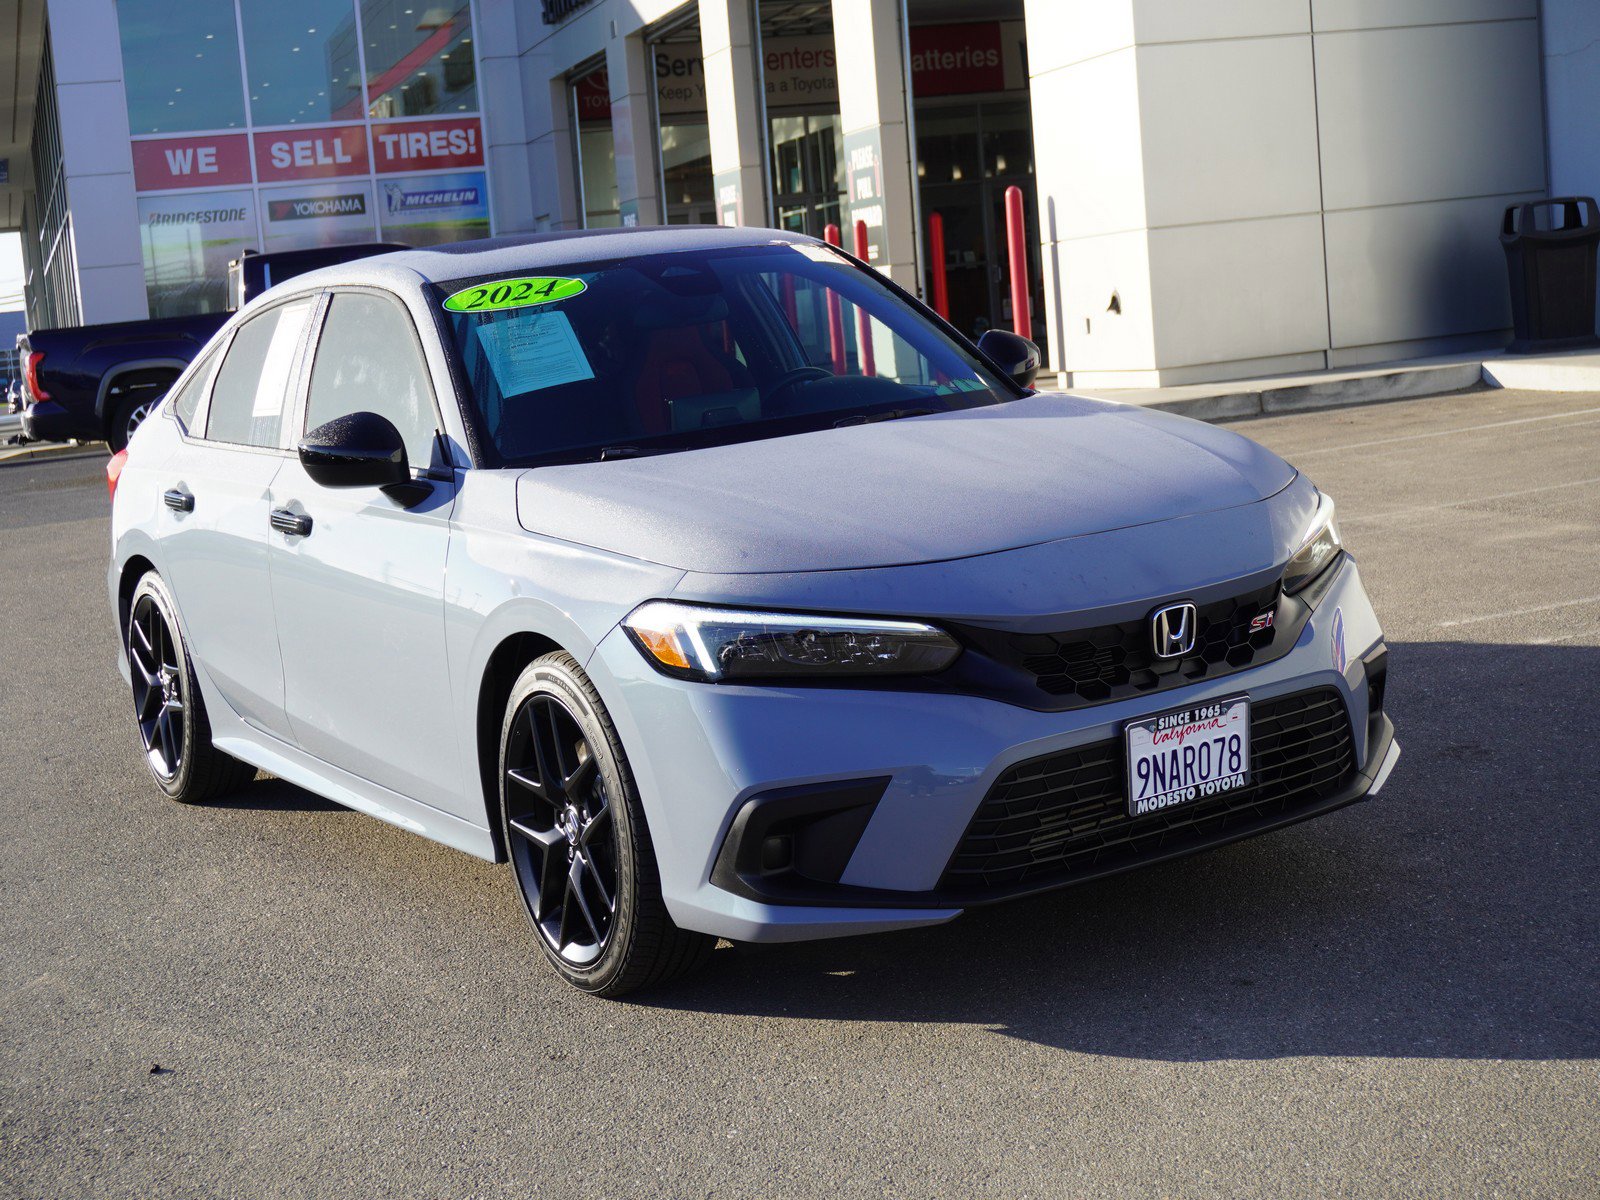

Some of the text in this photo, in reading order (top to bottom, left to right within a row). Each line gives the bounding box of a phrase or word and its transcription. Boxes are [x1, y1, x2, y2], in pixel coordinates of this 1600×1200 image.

[791, 77, 835, 93] Toyota
[165, 128, 476, 176] WE SELL TIRES!
[293, 197, 362, 216] YOKOHAMA
[405, 190, 476, 206] MICHELIN
[148, 207, 247, 227] BRIDGESTONE
[465, 279, 559, 309] 2024
[1157, 704, 1222, 730] SINCE 1965
[1152, 717, 1227, 746] California
[1137, 734, 1242, 799] 9NAR078
[1136, 773, 1246, 814] MODESTO TOYOTA
